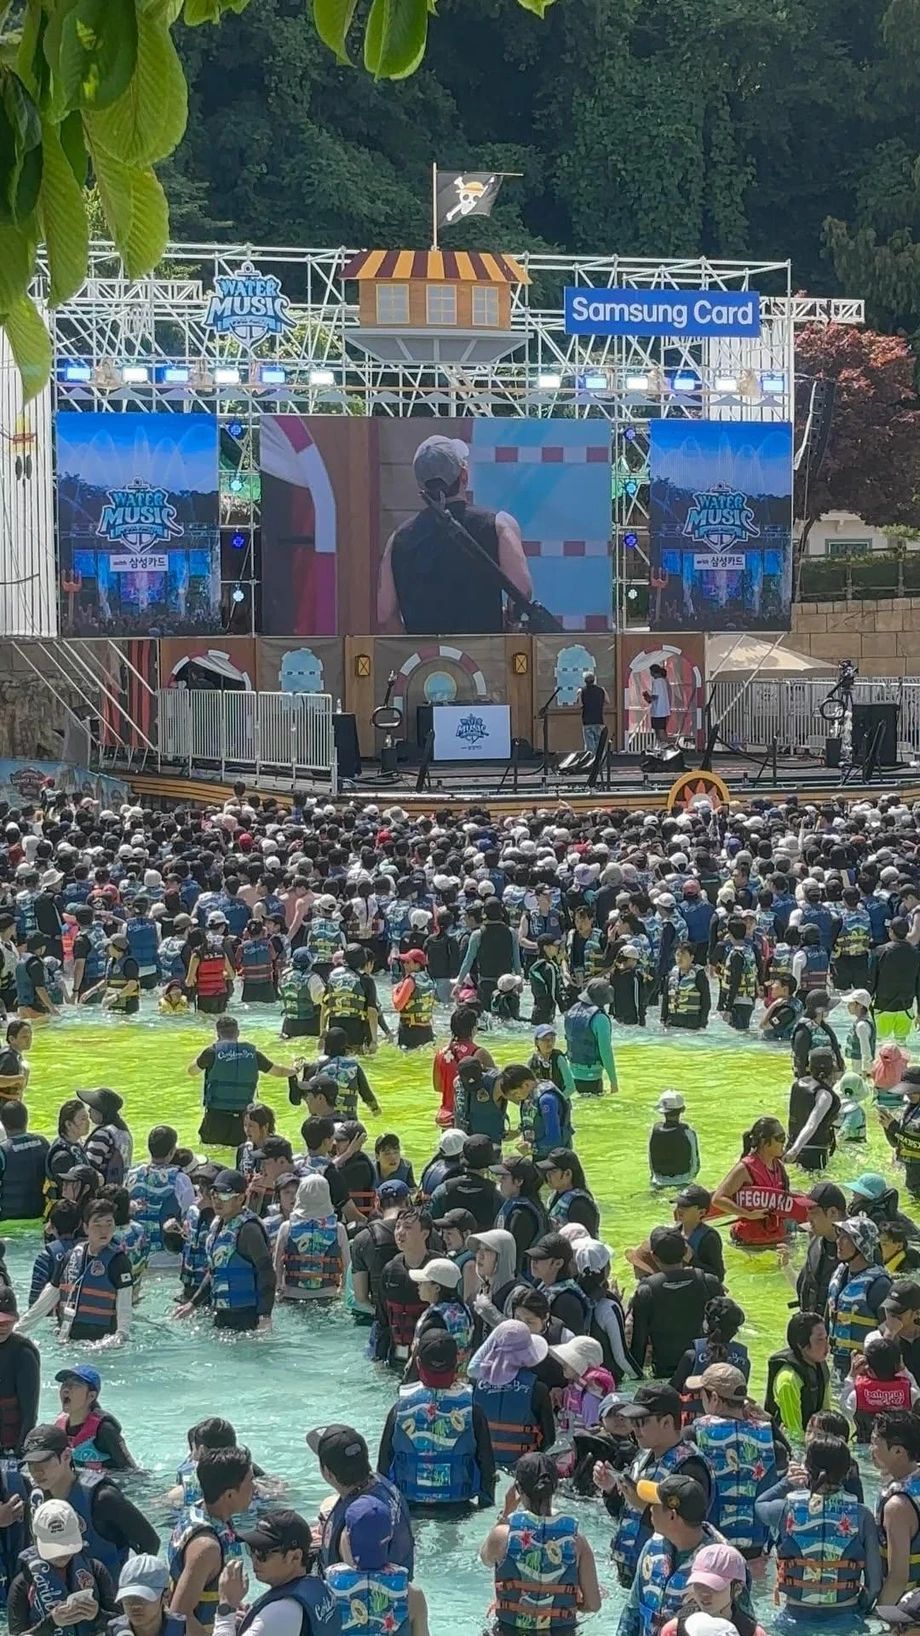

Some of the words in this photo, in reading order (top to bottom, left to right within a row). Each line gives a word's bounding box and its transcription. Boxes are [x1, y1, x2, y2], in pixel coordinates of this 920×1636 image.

[217, 279, 278, 296] WATER
[205, 296, 297, 326] MUSIC
[572, 296, 688, 328] Samsung
[693, 300, 753, 325] Card
[110, 491, 164, 507] WATER
[697, 494, 744, 509] WATER
[100, 507, 181, 533] MUSIC
[686, 508, 758, 534] MUSIC
[129, 556, 167, 569] 삼성카드
[711, 556, 744, 568] 삼성카드
